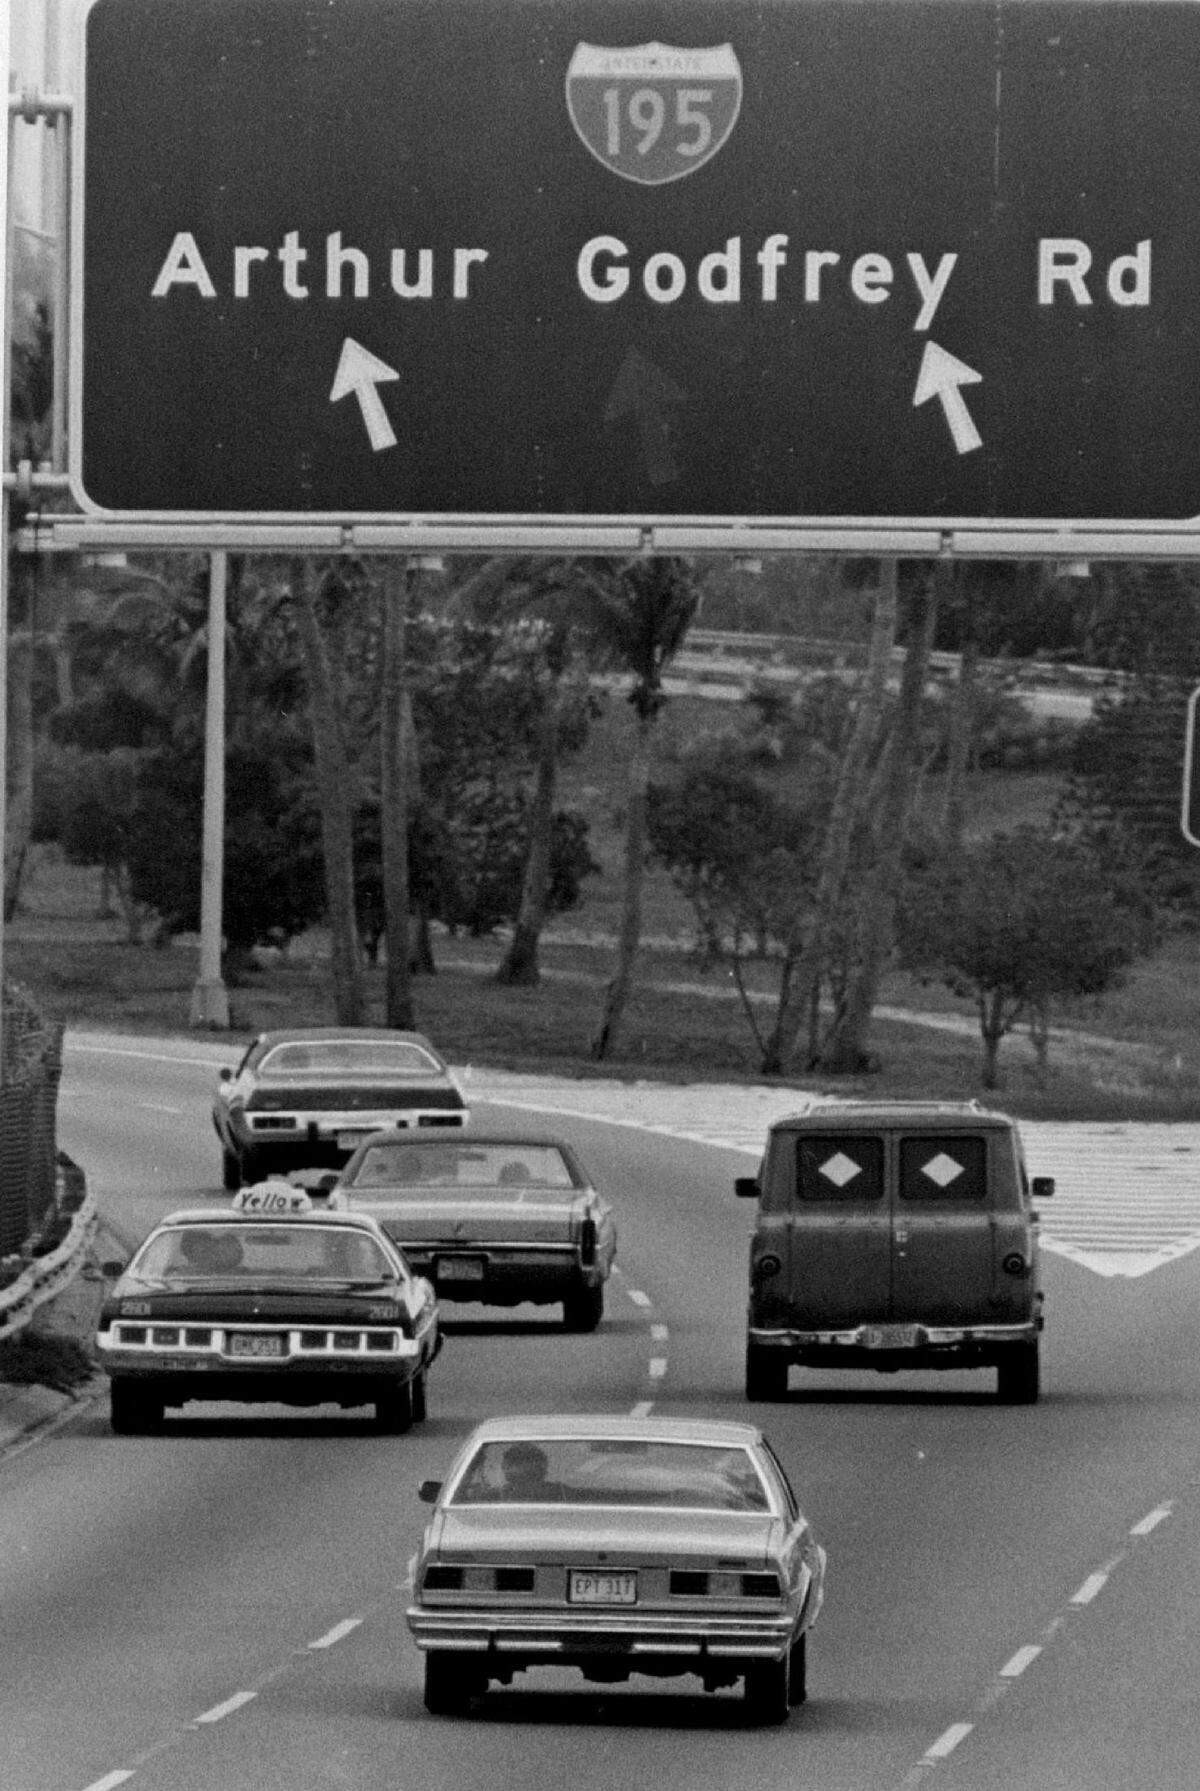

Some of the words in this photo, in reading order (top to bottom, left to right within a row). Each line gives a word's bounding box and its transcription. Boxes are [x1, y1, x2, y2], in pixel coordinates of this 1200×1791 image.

[603, 88, 714, 157] 195
[150, 230, 490, 300] Arthur
[576, 233, 959, 332] Godfrey
[1036, 237, 1153, 306] Rd
[240, 1192, 305, 1208] Yellow
